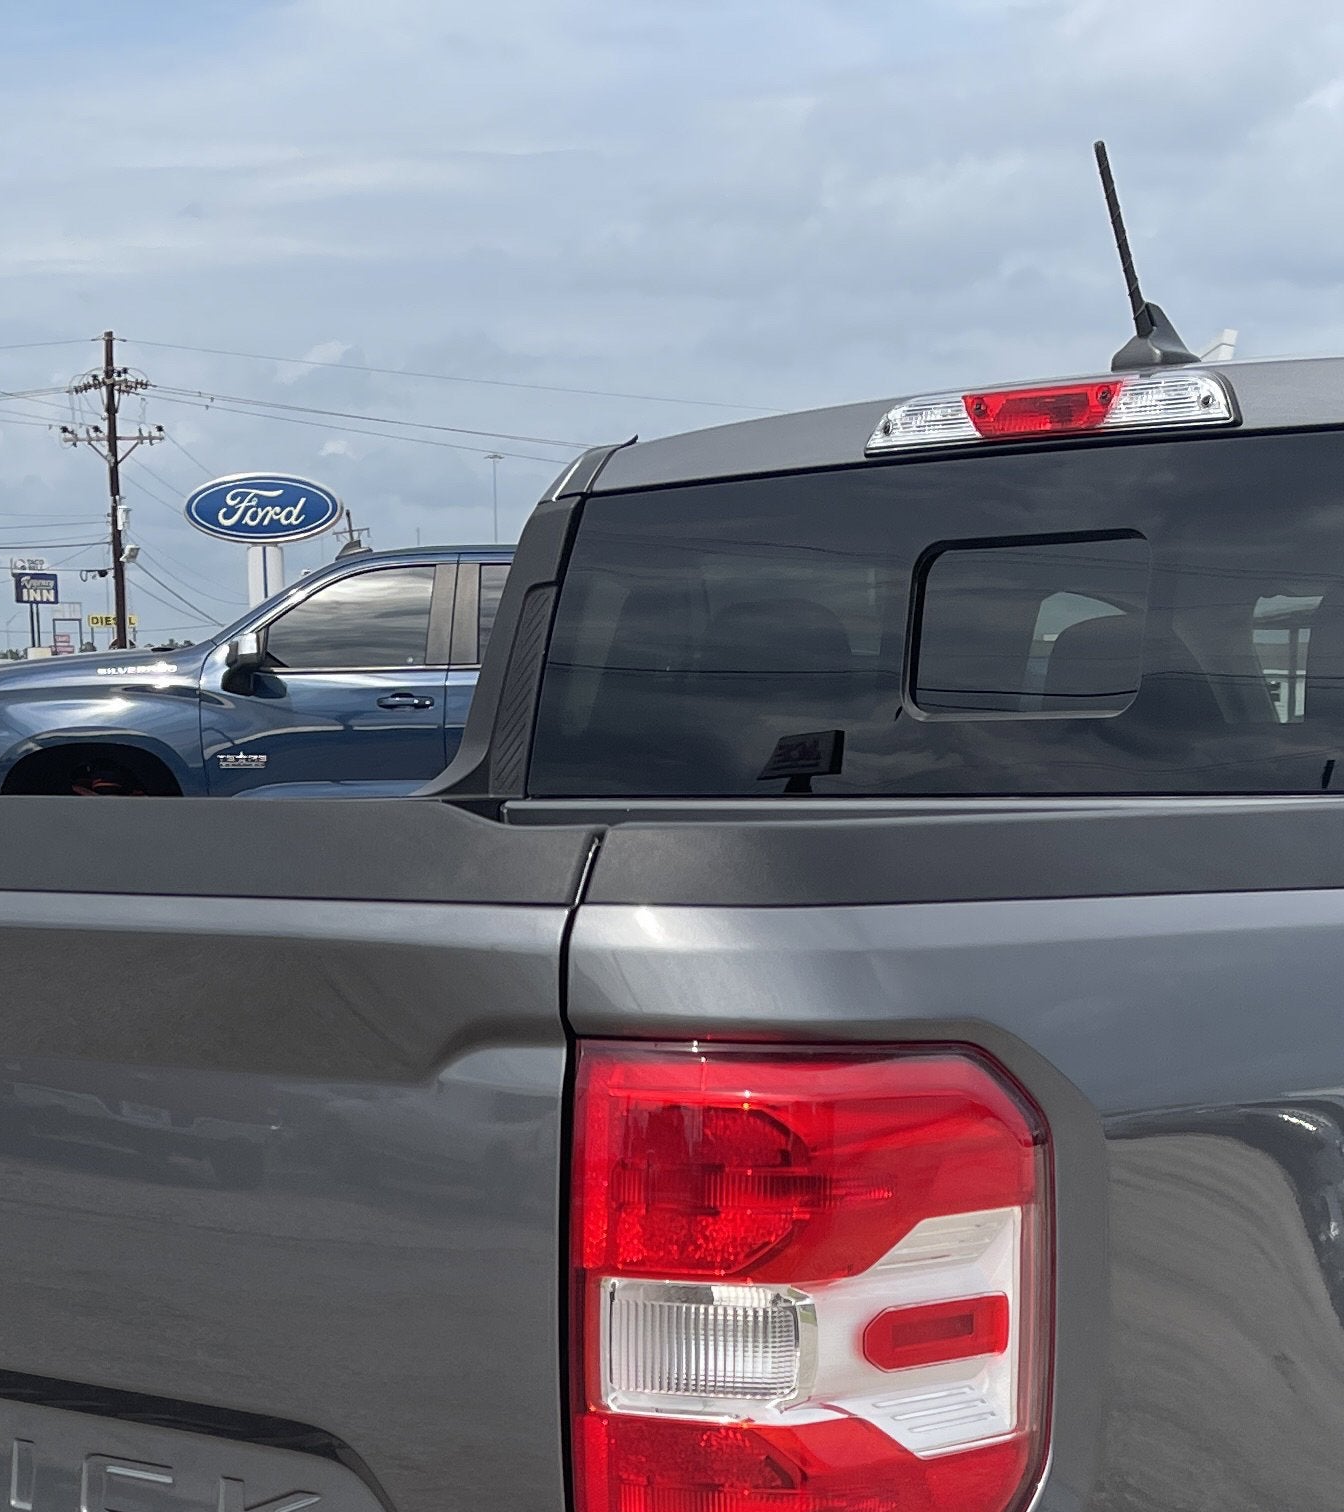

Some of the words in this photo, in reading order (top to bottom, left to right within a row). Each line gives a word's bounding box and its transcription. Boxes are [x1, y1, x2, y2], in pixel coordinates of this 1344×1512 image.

[218, 488, 307, 526] Ford
[22, 589, 54, 601] INN
[91, 616, 136, 626] DIESL
